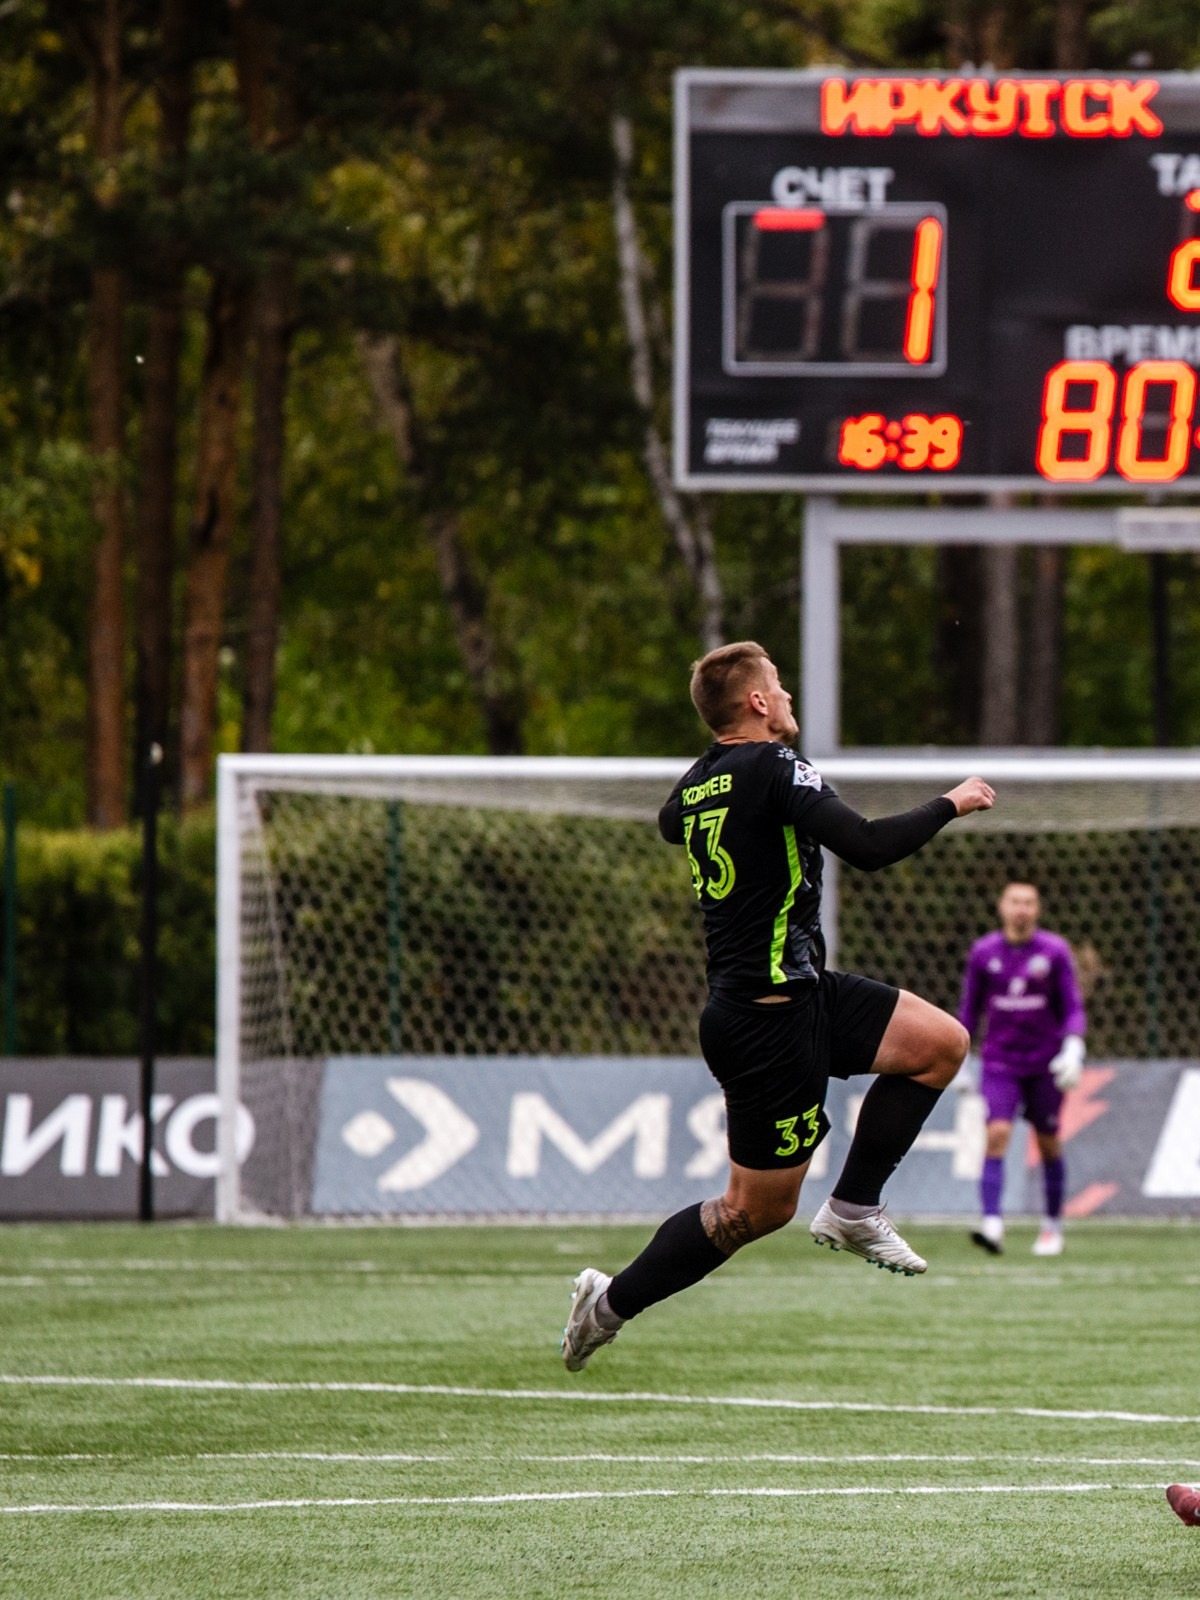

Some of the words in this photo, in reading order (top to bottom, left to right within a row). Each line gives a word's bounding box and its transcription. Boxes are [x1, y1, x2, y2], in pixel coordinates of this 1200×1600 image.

[820, 77, 1163, 138] ИРКУТСК
[771, 166, 894, 209] СЧЕТ
[902, 216, 943, 366] 1
[773, 1102, 821, 1157] 33
